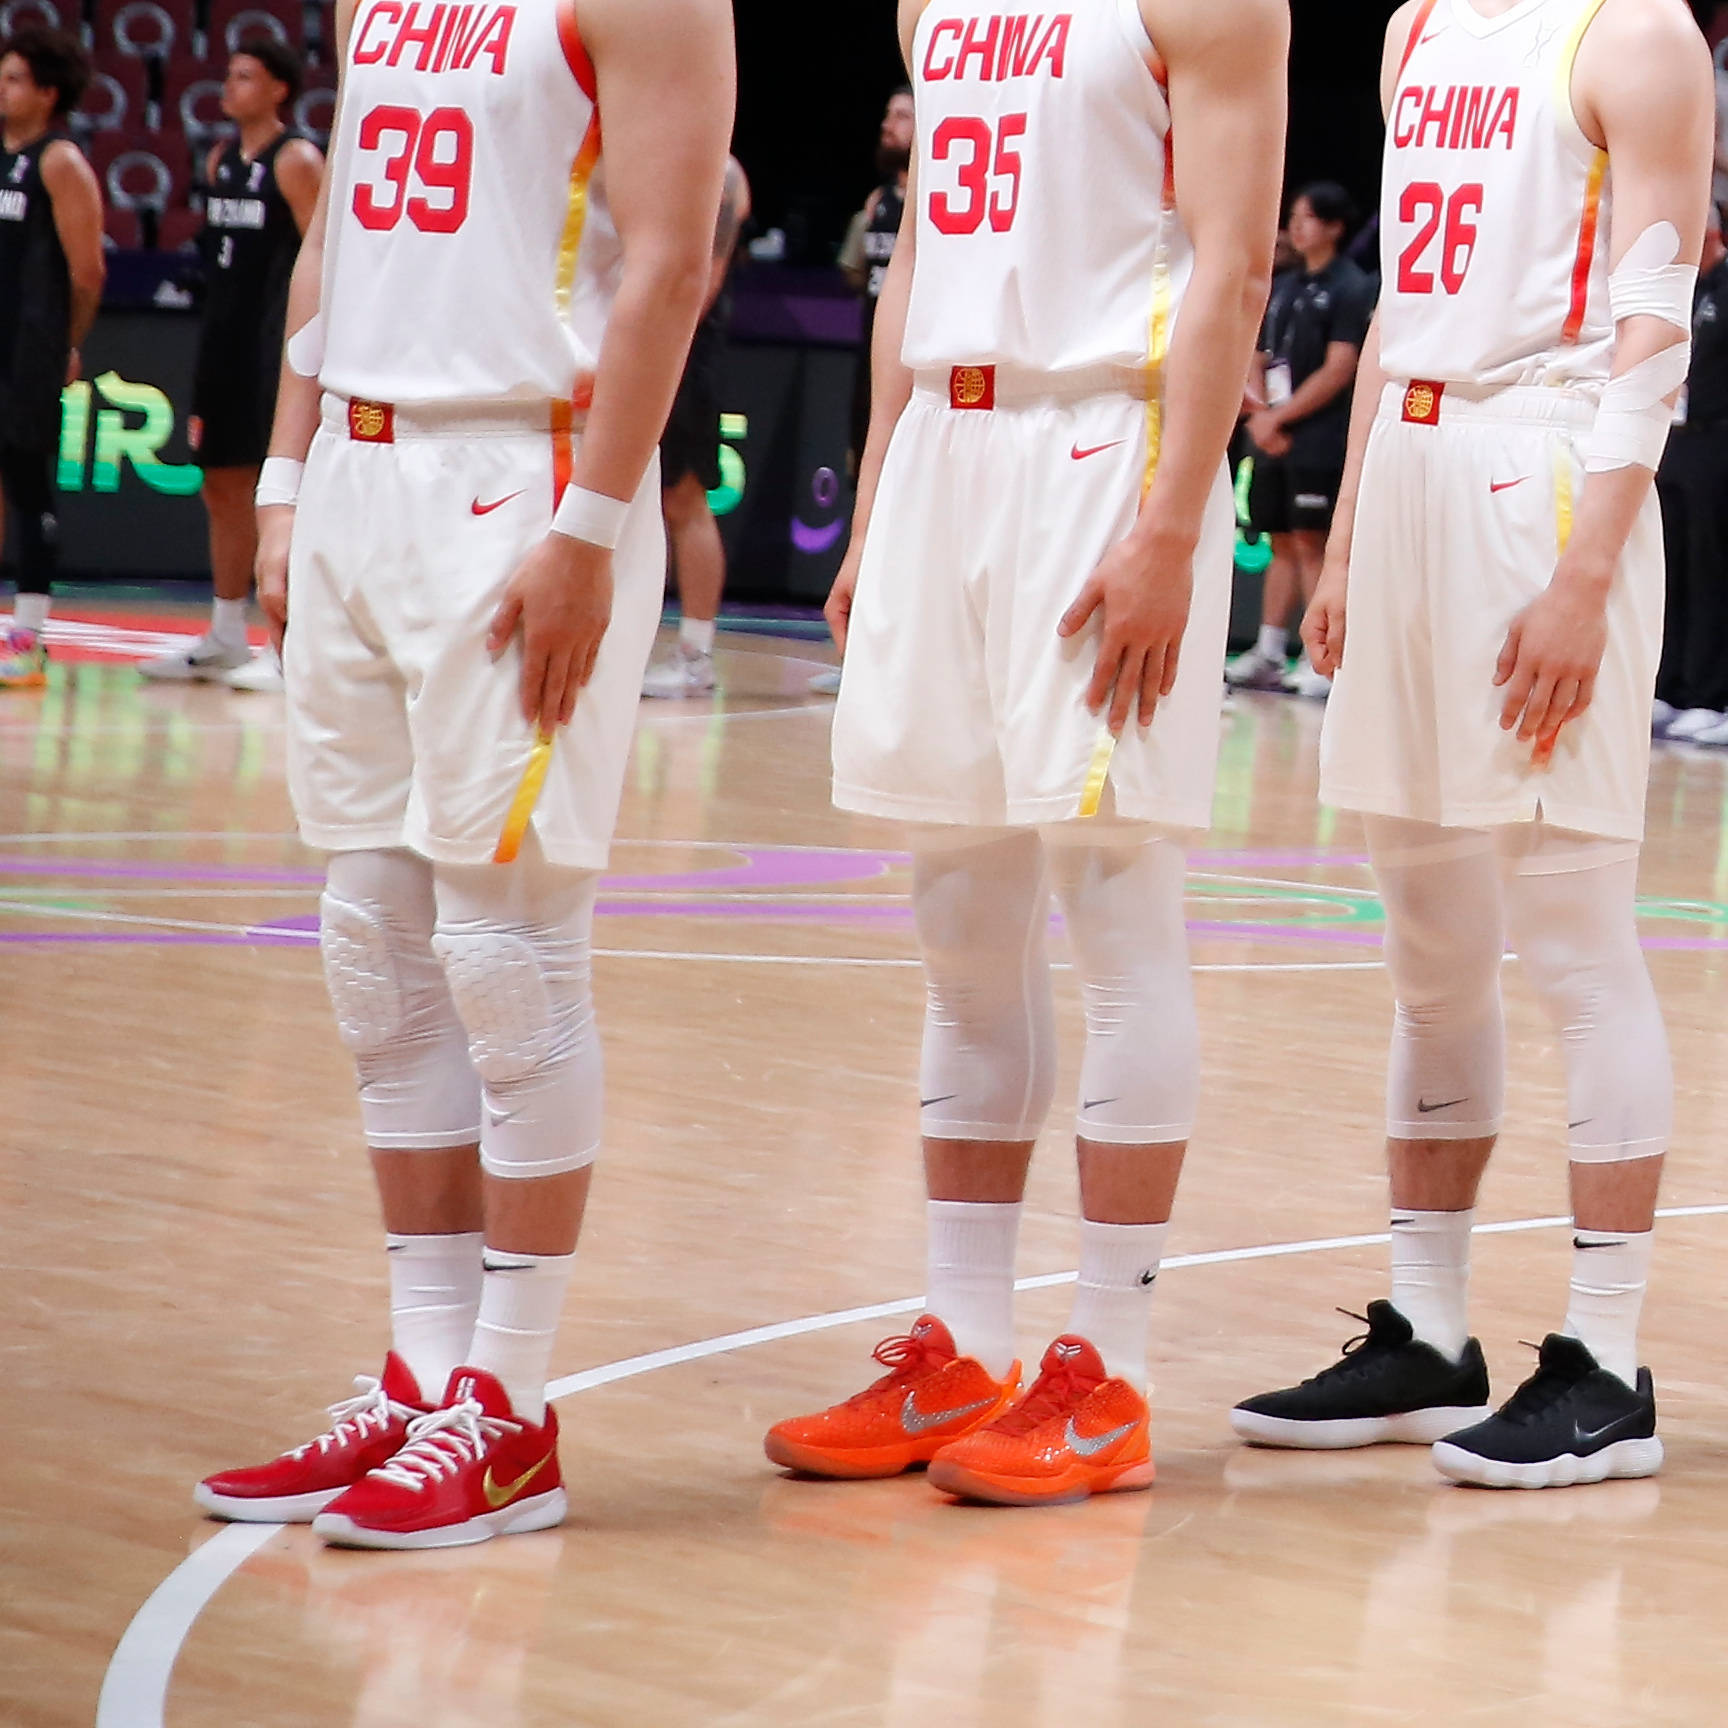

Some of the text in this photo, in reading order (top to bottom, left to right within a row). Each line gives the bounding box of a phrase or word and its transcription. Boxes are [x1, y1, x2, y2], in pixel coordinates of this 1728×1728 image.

[922, 13, 1072, 82] CHINA
[352, 104, 474, 234] 39
[928, 112, 1027, 235] 35
[1393, 85, 1520, 150] CHINA
[1396, 181, 1484, 295] 26
